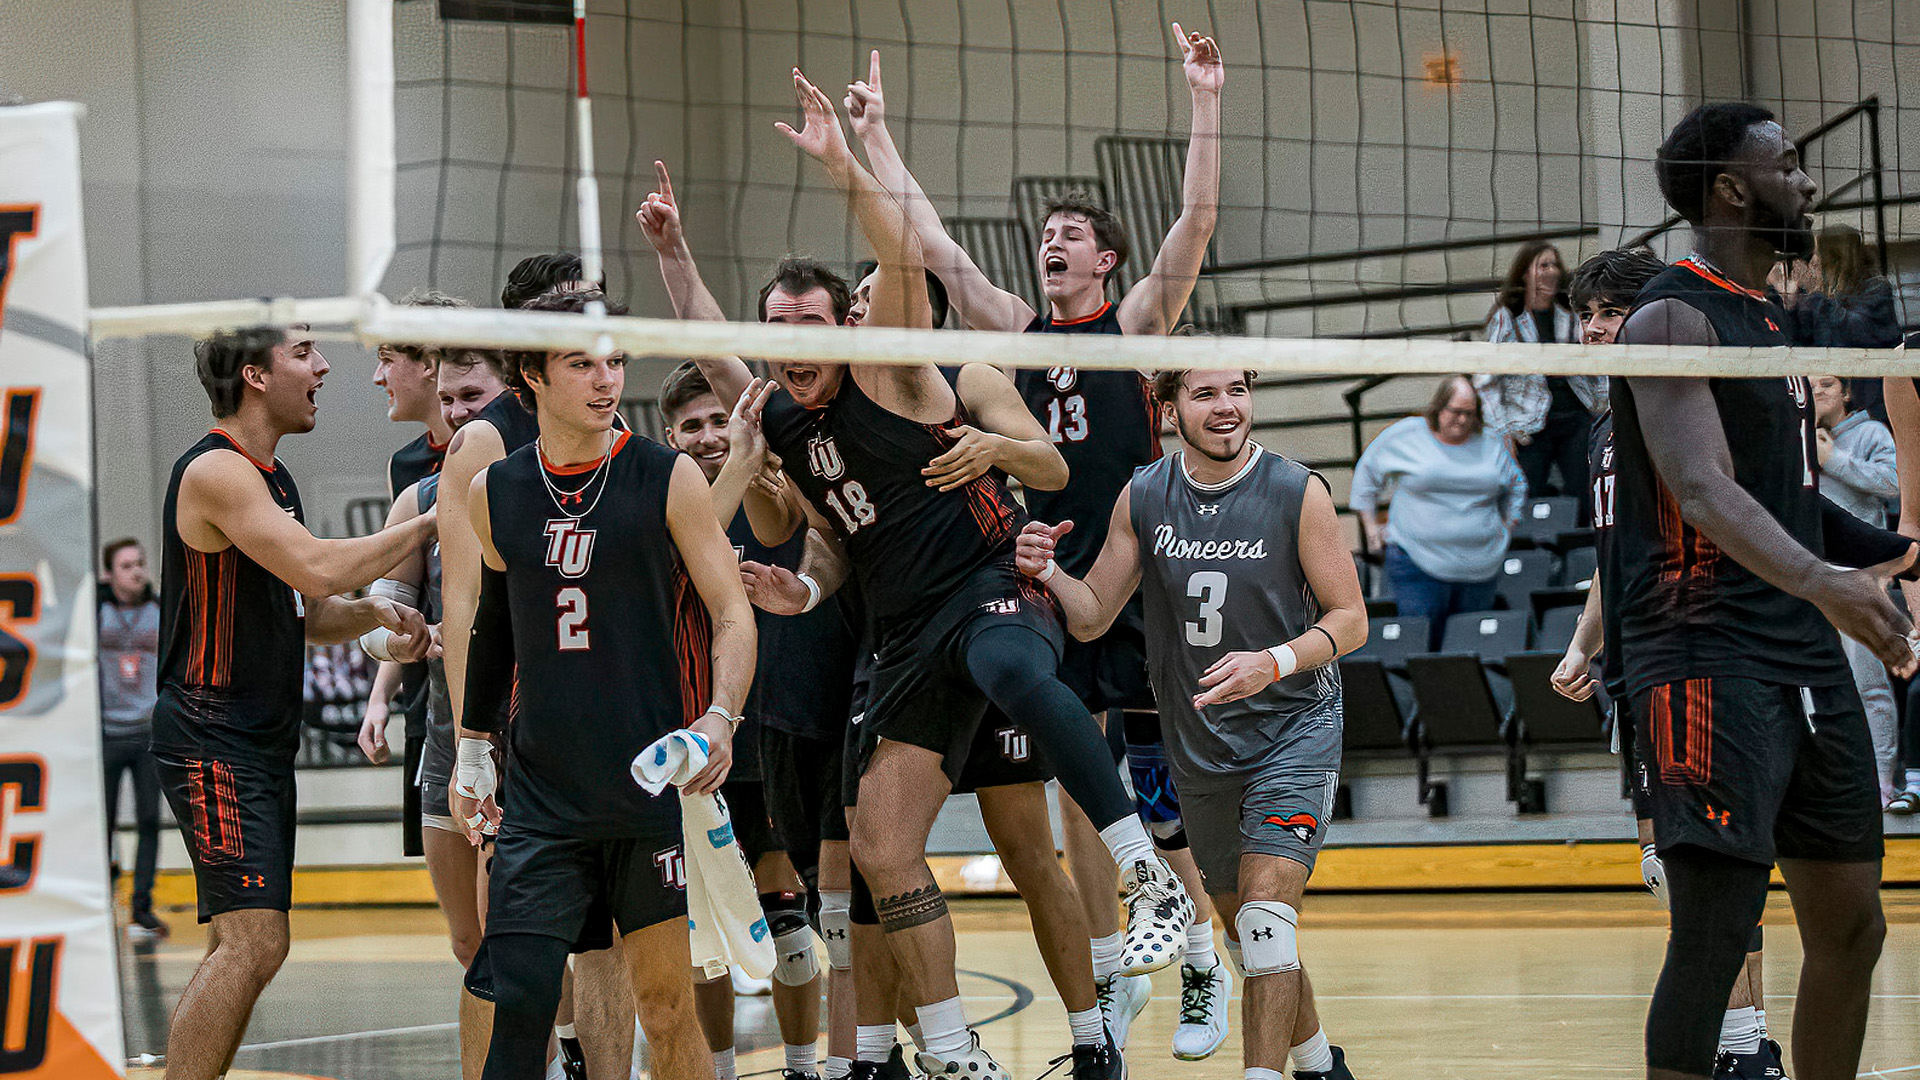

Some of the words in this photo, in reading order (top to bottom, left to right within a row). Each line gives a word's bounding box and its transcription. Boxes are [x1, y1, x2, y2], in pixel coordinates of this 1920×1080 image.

[1048, 395, 1088, 442] 13
[1800, 418, 1813, 487] 1
[825, 480, 877, 535] 18
[1593, 474, 1616, 528] 17
[543, 518, 597, 578] TU
[1153, 524, 1268, 559] Pioneers
[556, 587, 590, 651] 2
[1185, 571, 1229, 648] 3
[995, 726, 1032, 763] TU
[653, 843, 687, 891] TU
